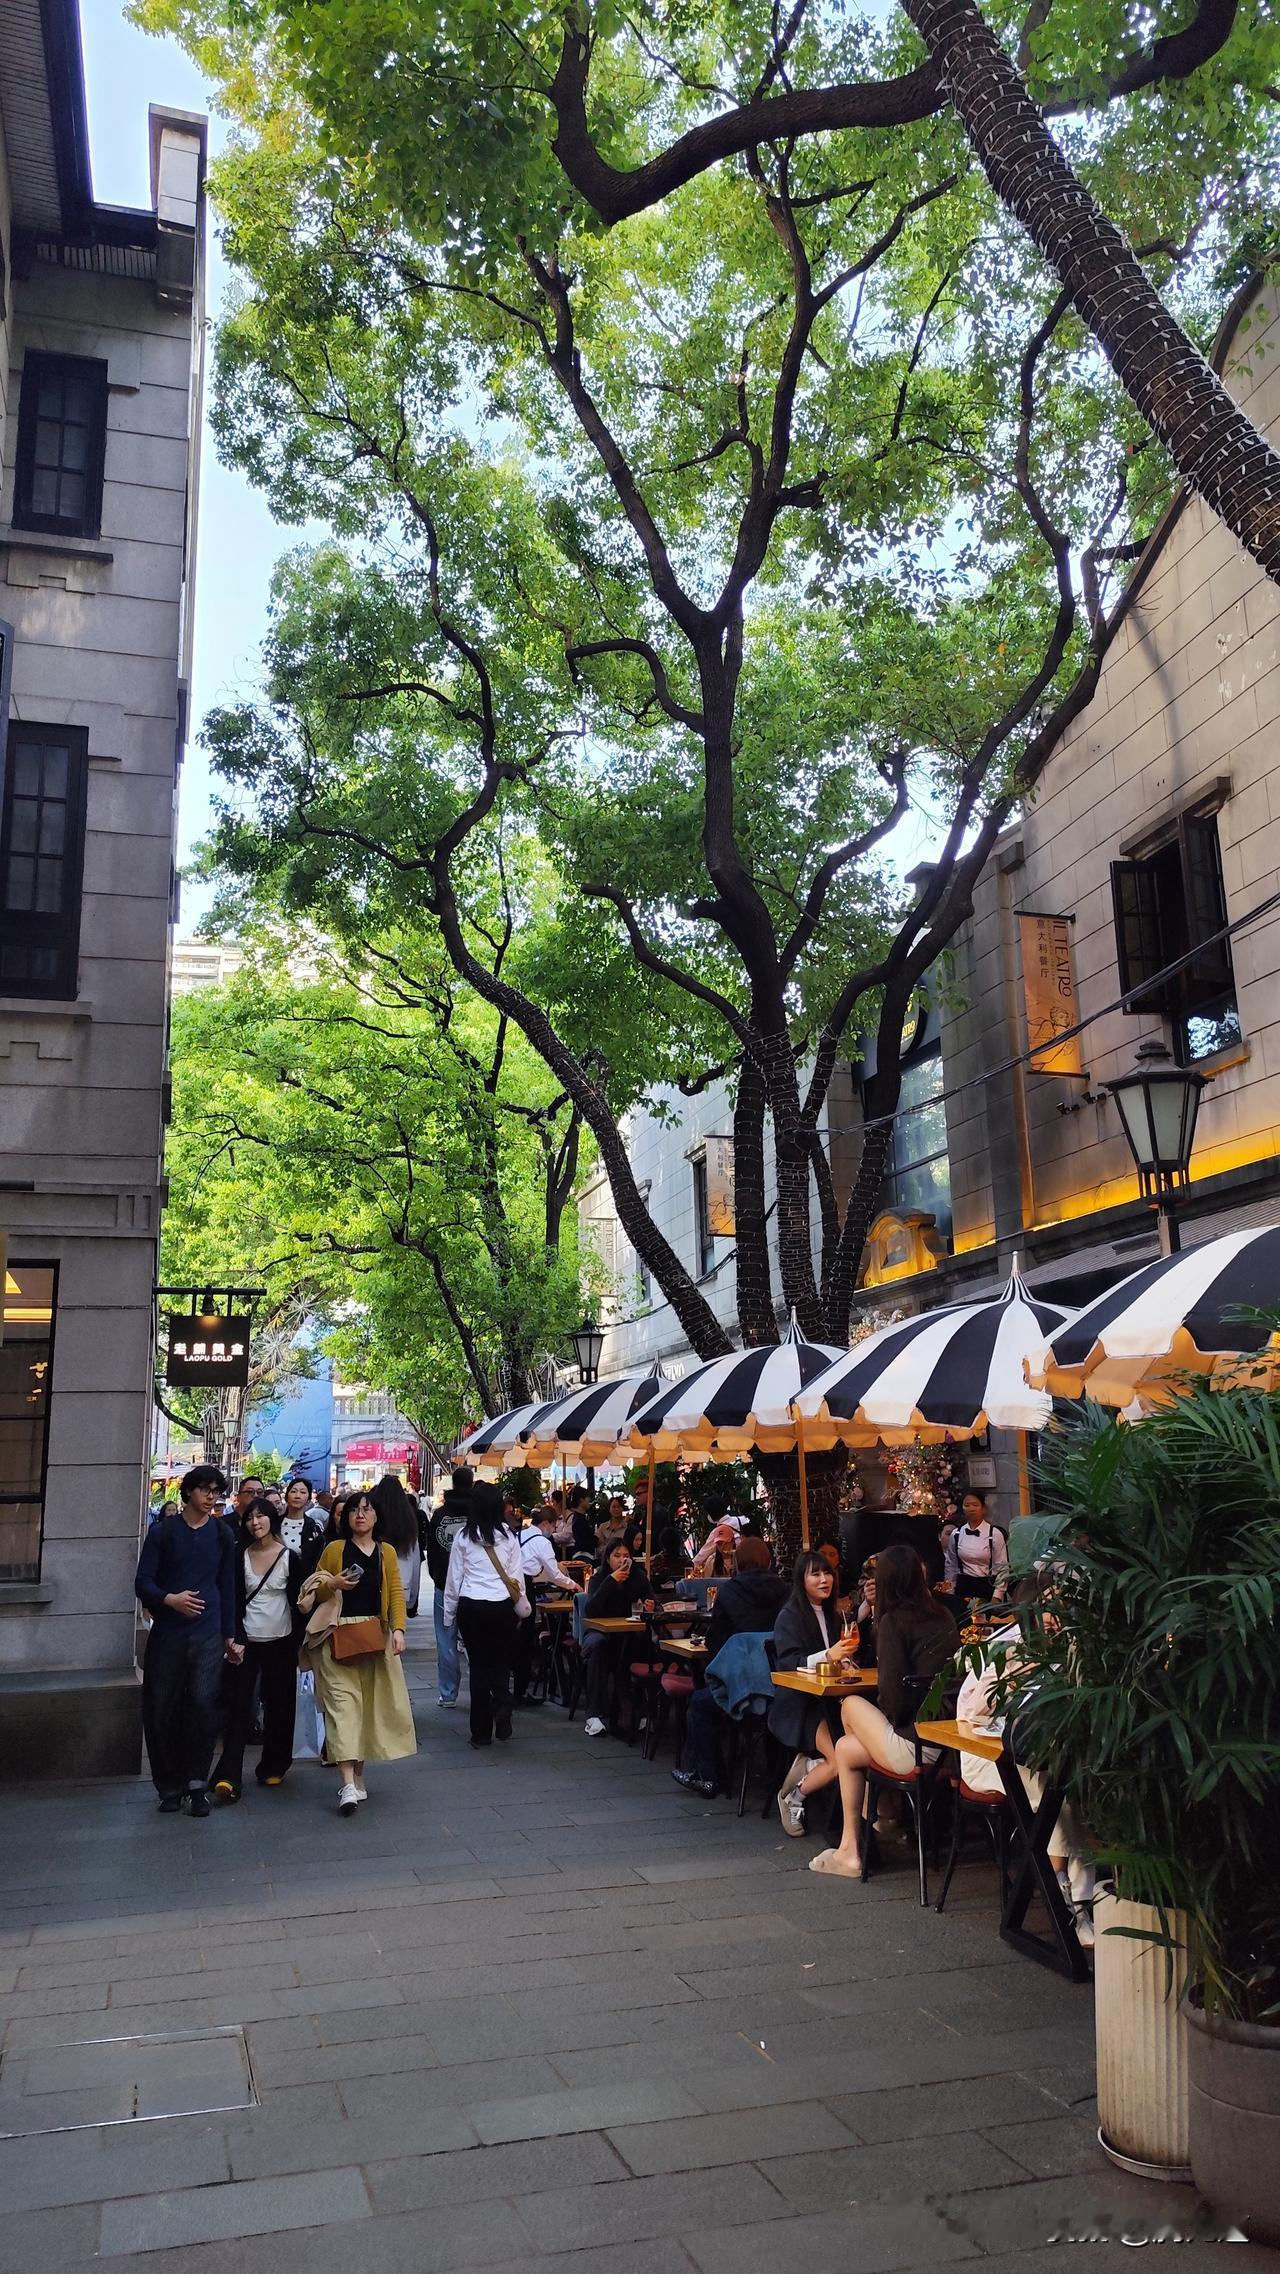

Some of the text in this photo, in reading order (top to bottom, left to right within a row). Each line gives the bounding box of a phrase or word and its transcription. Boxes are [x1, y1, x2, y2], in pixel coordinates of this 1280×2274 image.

[1053, 920, 1072, 997] IL TEATRO
[184, 1354, 233, 1362] LAOPU GOLD
